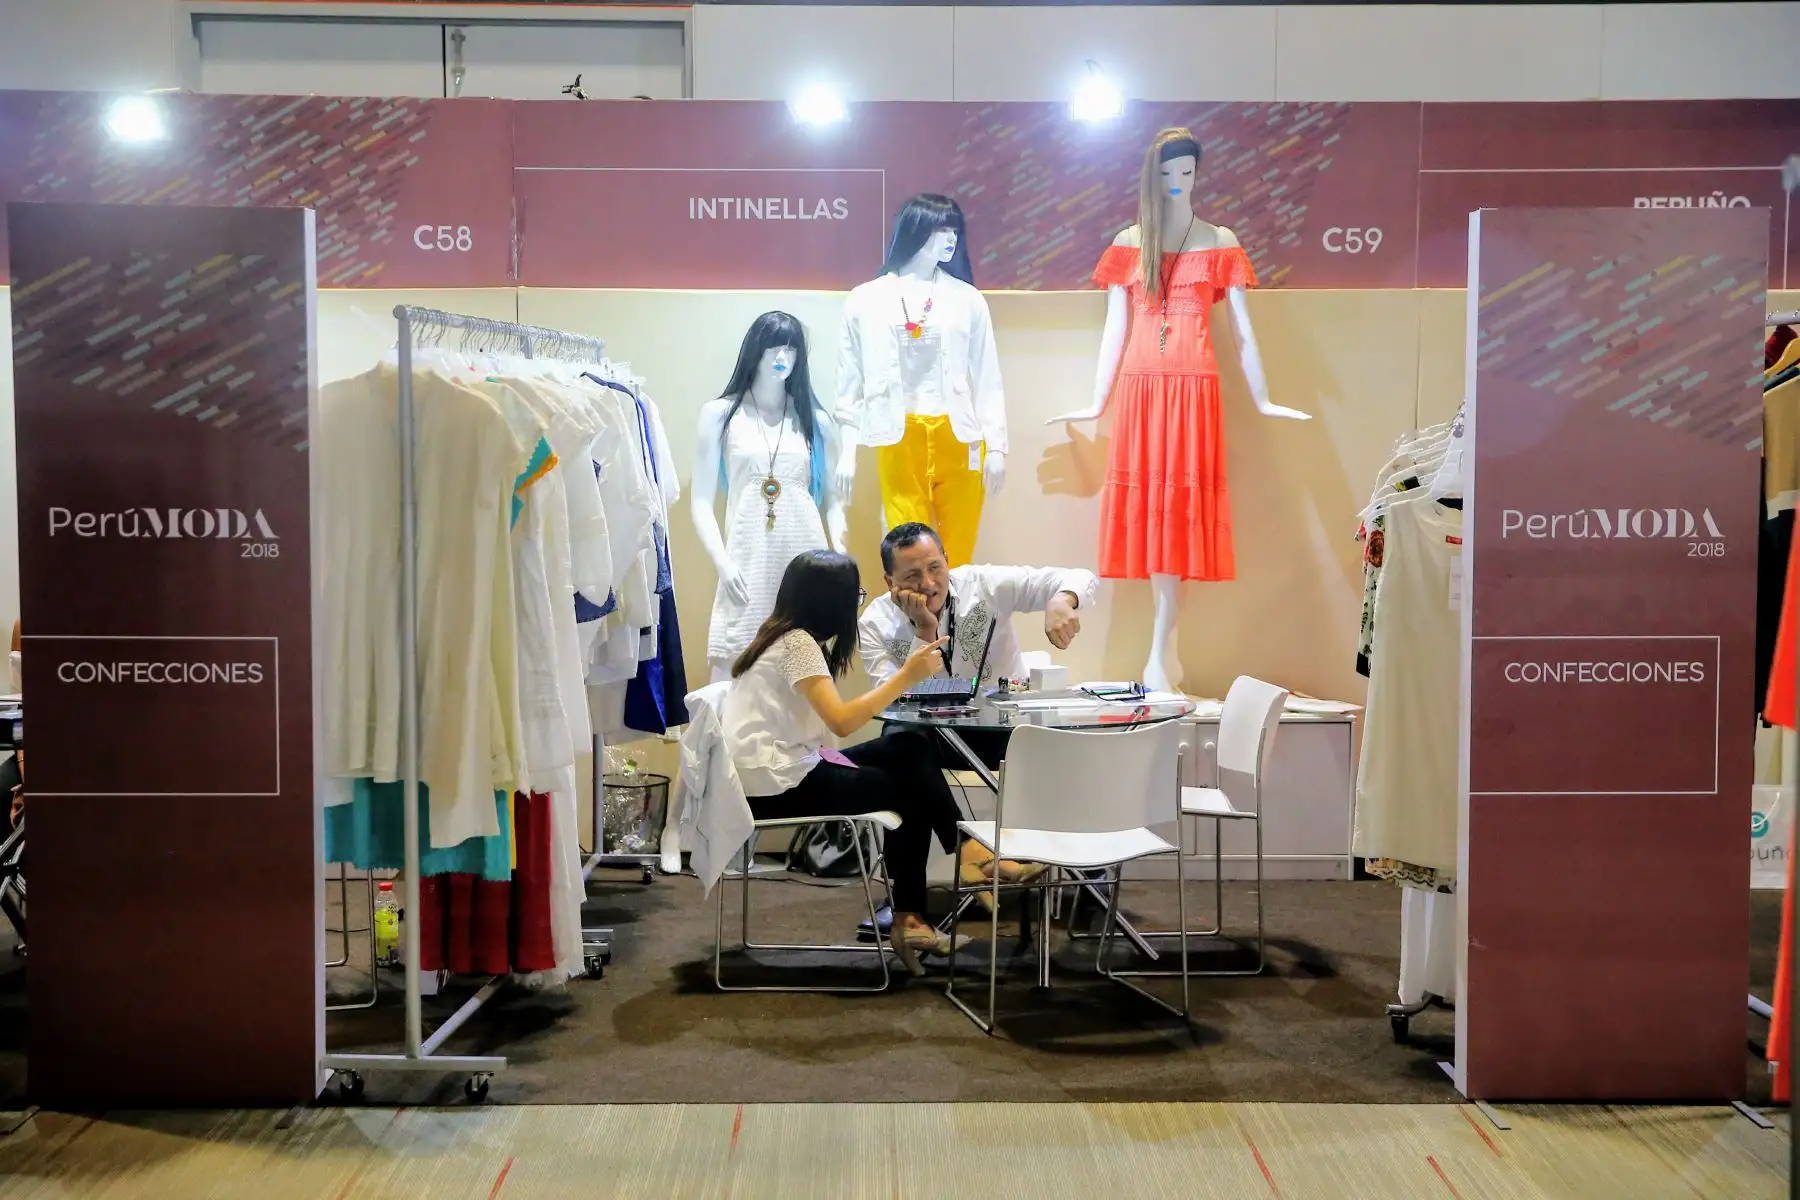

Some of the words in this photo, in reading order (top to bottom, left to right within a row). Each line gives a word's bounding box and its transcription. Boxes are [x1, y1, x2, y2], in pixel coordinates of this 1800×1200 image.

[689, 197, 849, 220] INTINELLAS
[413, 224, 473, 252] C58
[1322, 226, 1383, 254] C59
[240, 543, 280, 558] 2018
[1687, 542, 1725, 557] 2018
[57, 661, 264, 684] CONFECCIONES
[1504, 661, 1705, 683] CONFECCIONES
